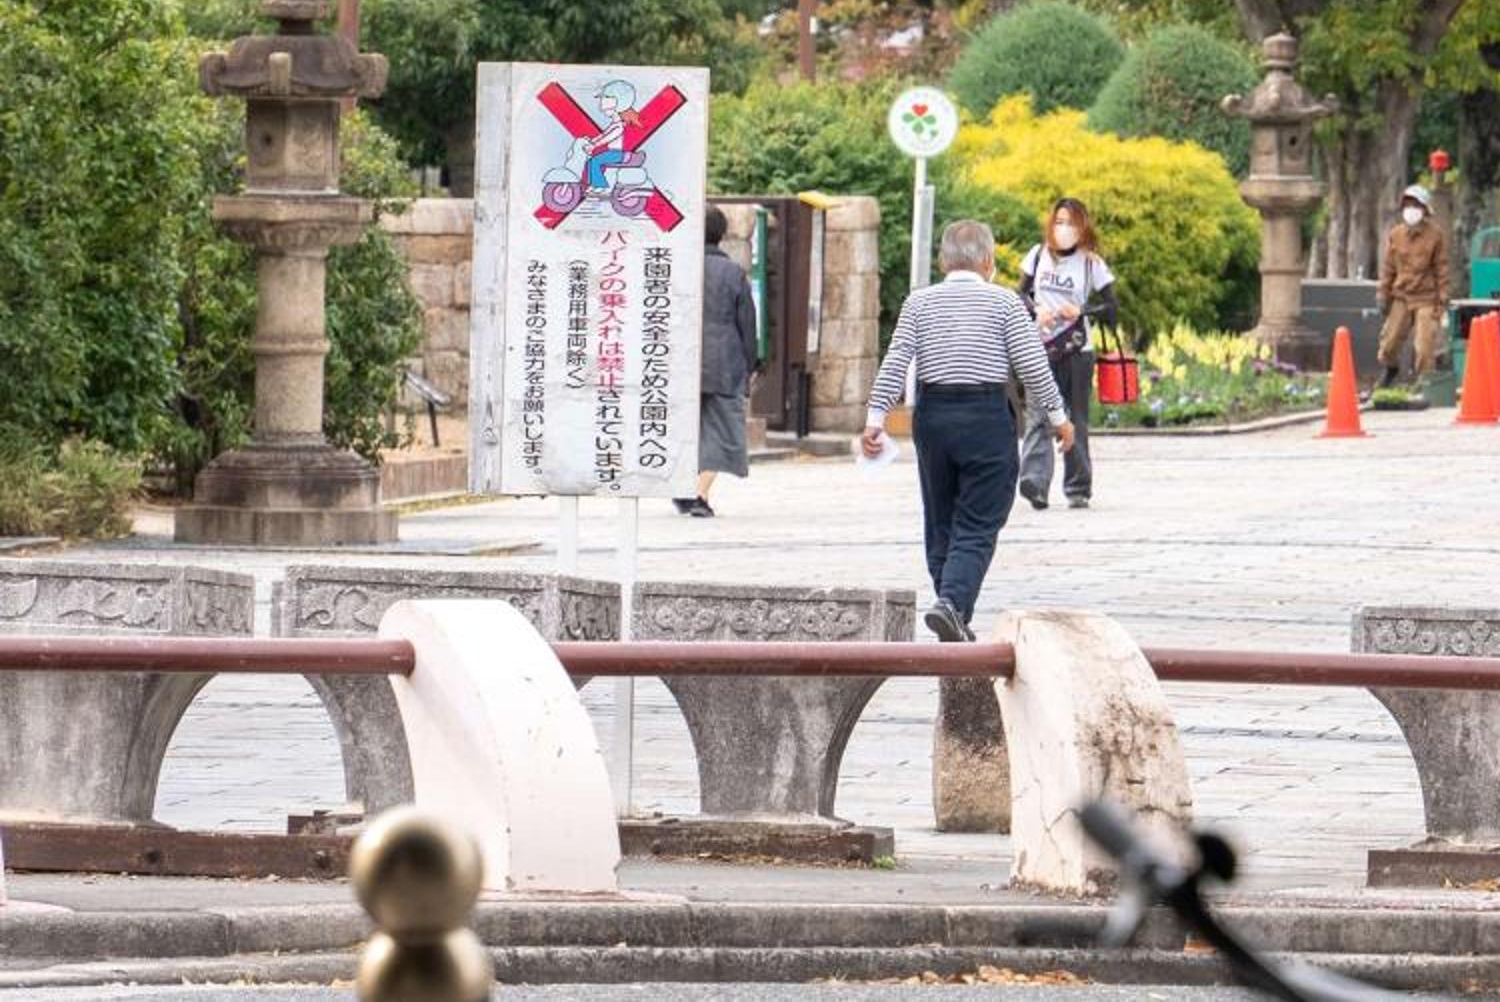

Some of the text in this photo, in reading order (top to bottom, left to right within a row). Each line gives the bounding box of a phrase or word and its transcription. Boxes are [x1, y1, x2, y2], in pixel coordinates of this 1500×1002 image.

[523, 260, 548, 475] みなさまのご協力をお願いします。
[640, 247, 672, 468] 来園者の安全のため公園内への
[1040, 271, 1074, 288] FILA
